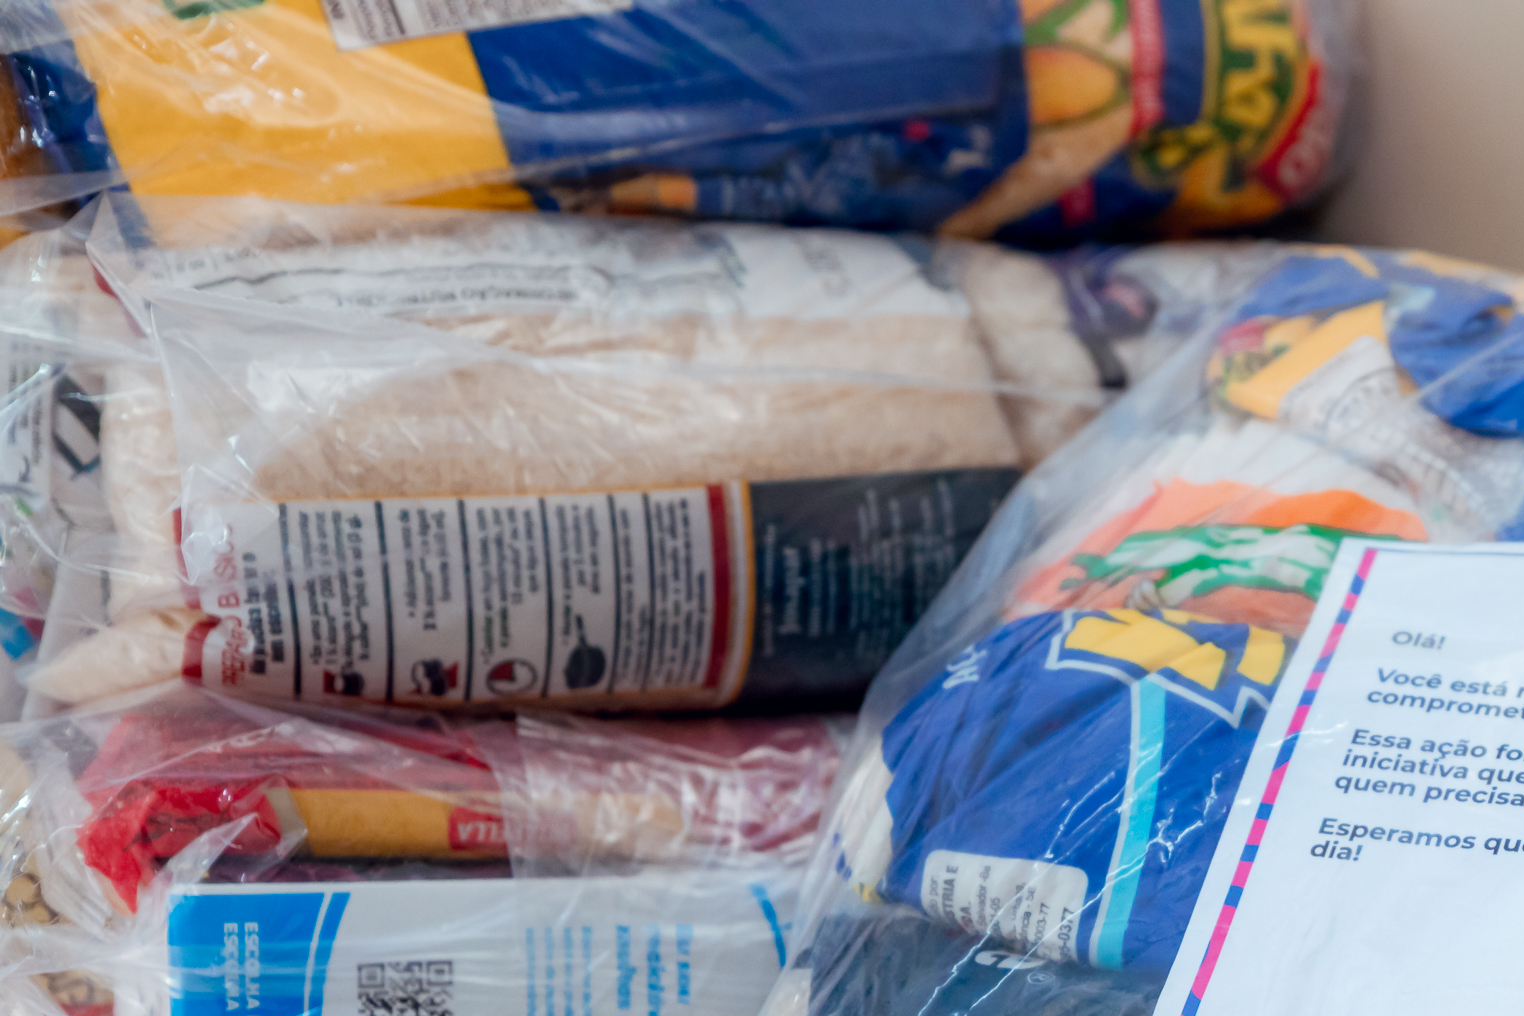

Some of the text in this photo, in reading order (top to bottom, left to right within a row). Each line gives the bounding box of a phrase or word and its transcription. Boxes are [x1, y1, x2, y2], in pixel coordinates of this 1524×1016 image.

[1391, 631, 1447, 651] Olá!
[1377, 667, 1443, 690] Você
[1450, 680, 1509, 698] está
[1350, 728, 1412, 751] Essa
[1420, 738, 1488, 760] ação
[1342, 749, 1470, 781] iniciativa
[1334, 775, 1417, 798] quem
[1318, 817, 1477, 850] Esperamos
[1310, 839, 1364, 863] dia!
[244, 922, 260, 1009] ESCOLHA
